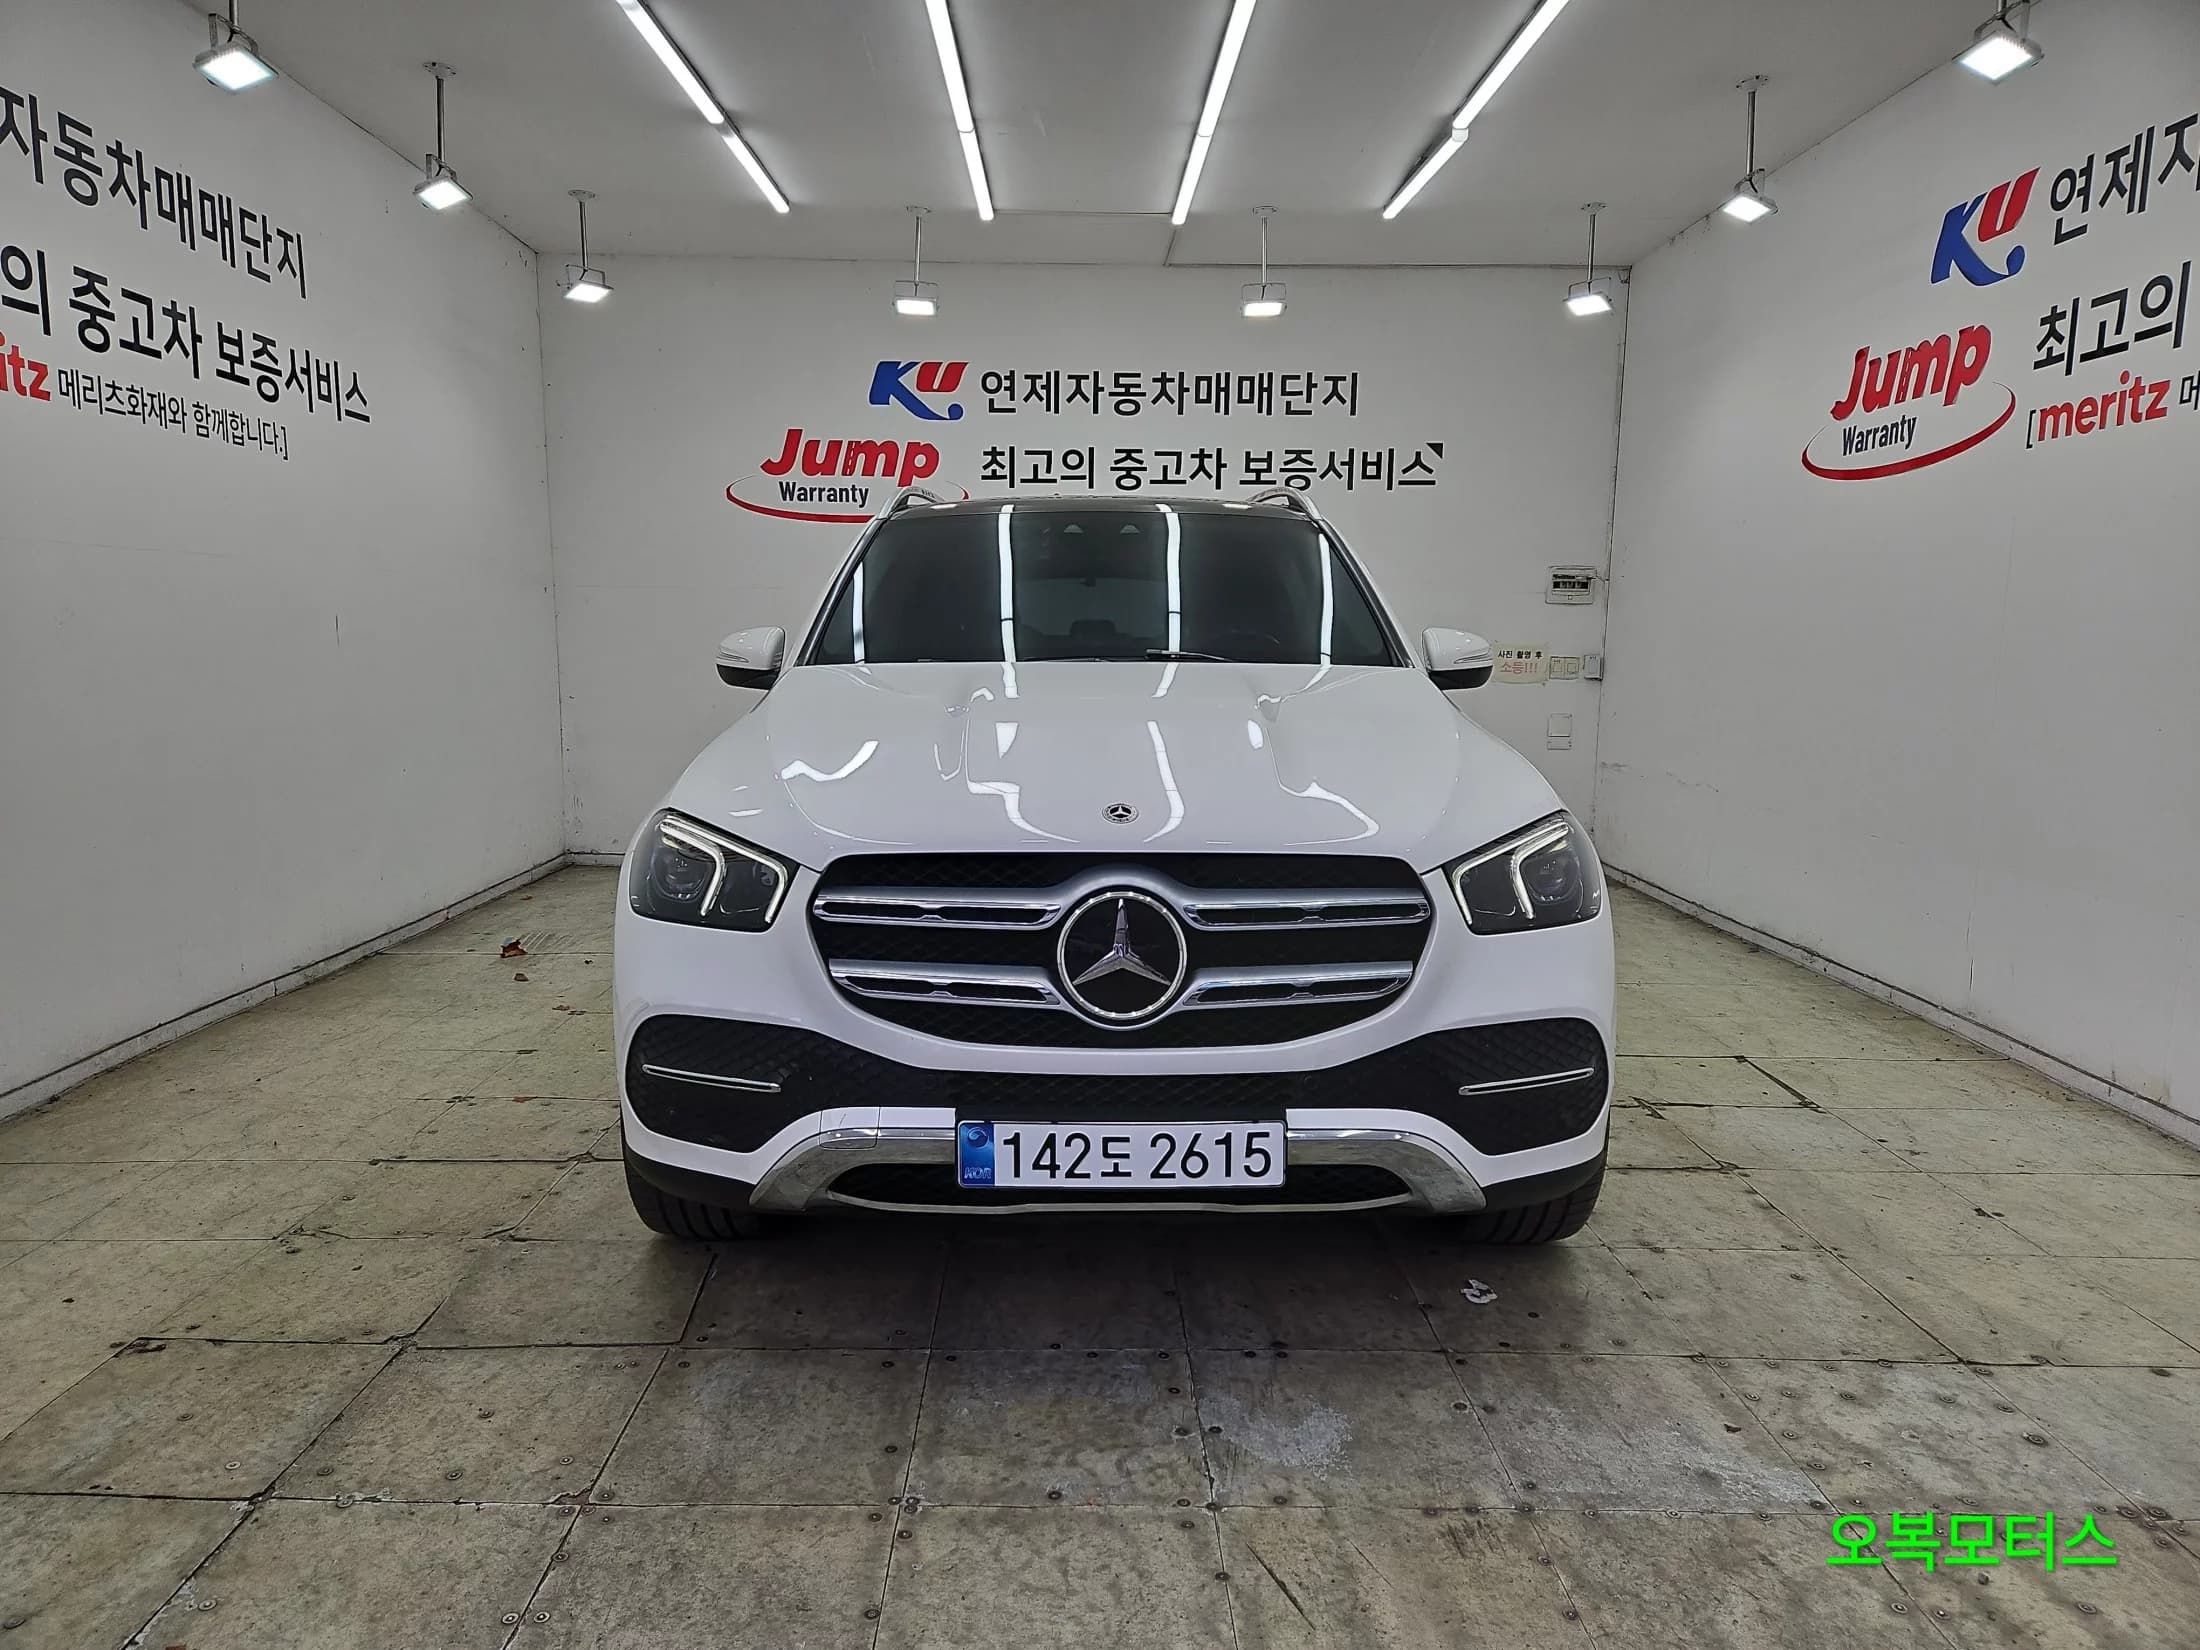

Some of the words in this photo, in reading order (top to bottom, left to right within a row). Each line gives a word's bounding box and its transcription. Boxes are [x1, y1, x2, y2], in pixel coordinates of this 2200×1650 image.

[0, 86, 306, 299] 자동차매매단지
[1, 245, 51, 336] 의
[69, 266, 202, 379] 중고차
[215, 322, 370, 423] 보증서비스
[2033, 261, 2191, 376] 최고의
[981, 370, 1359, 416] 연제자동차매매단지
[1830, 325, 1991, 421] Jump
[58, 369, 187, 433] 메리츠화재와
[191, 402, 288, 460] 함께합니다.]
[1842, 415, 1916, 456] Warranty
[760, 429, 939, 487] Jump
[981, 446, 1095, 489] 최고의
[1110, 447, 1227, 490] 중고차
[1239, 448, 1437, 491] 보증서비스
[779, 481, 869, 508] Warranty
[1498, 650, 1512, 659] 사진
[1003, 1132, 1132, 1179] 142도
[1150, 1132, 1271, 1179] 2615
